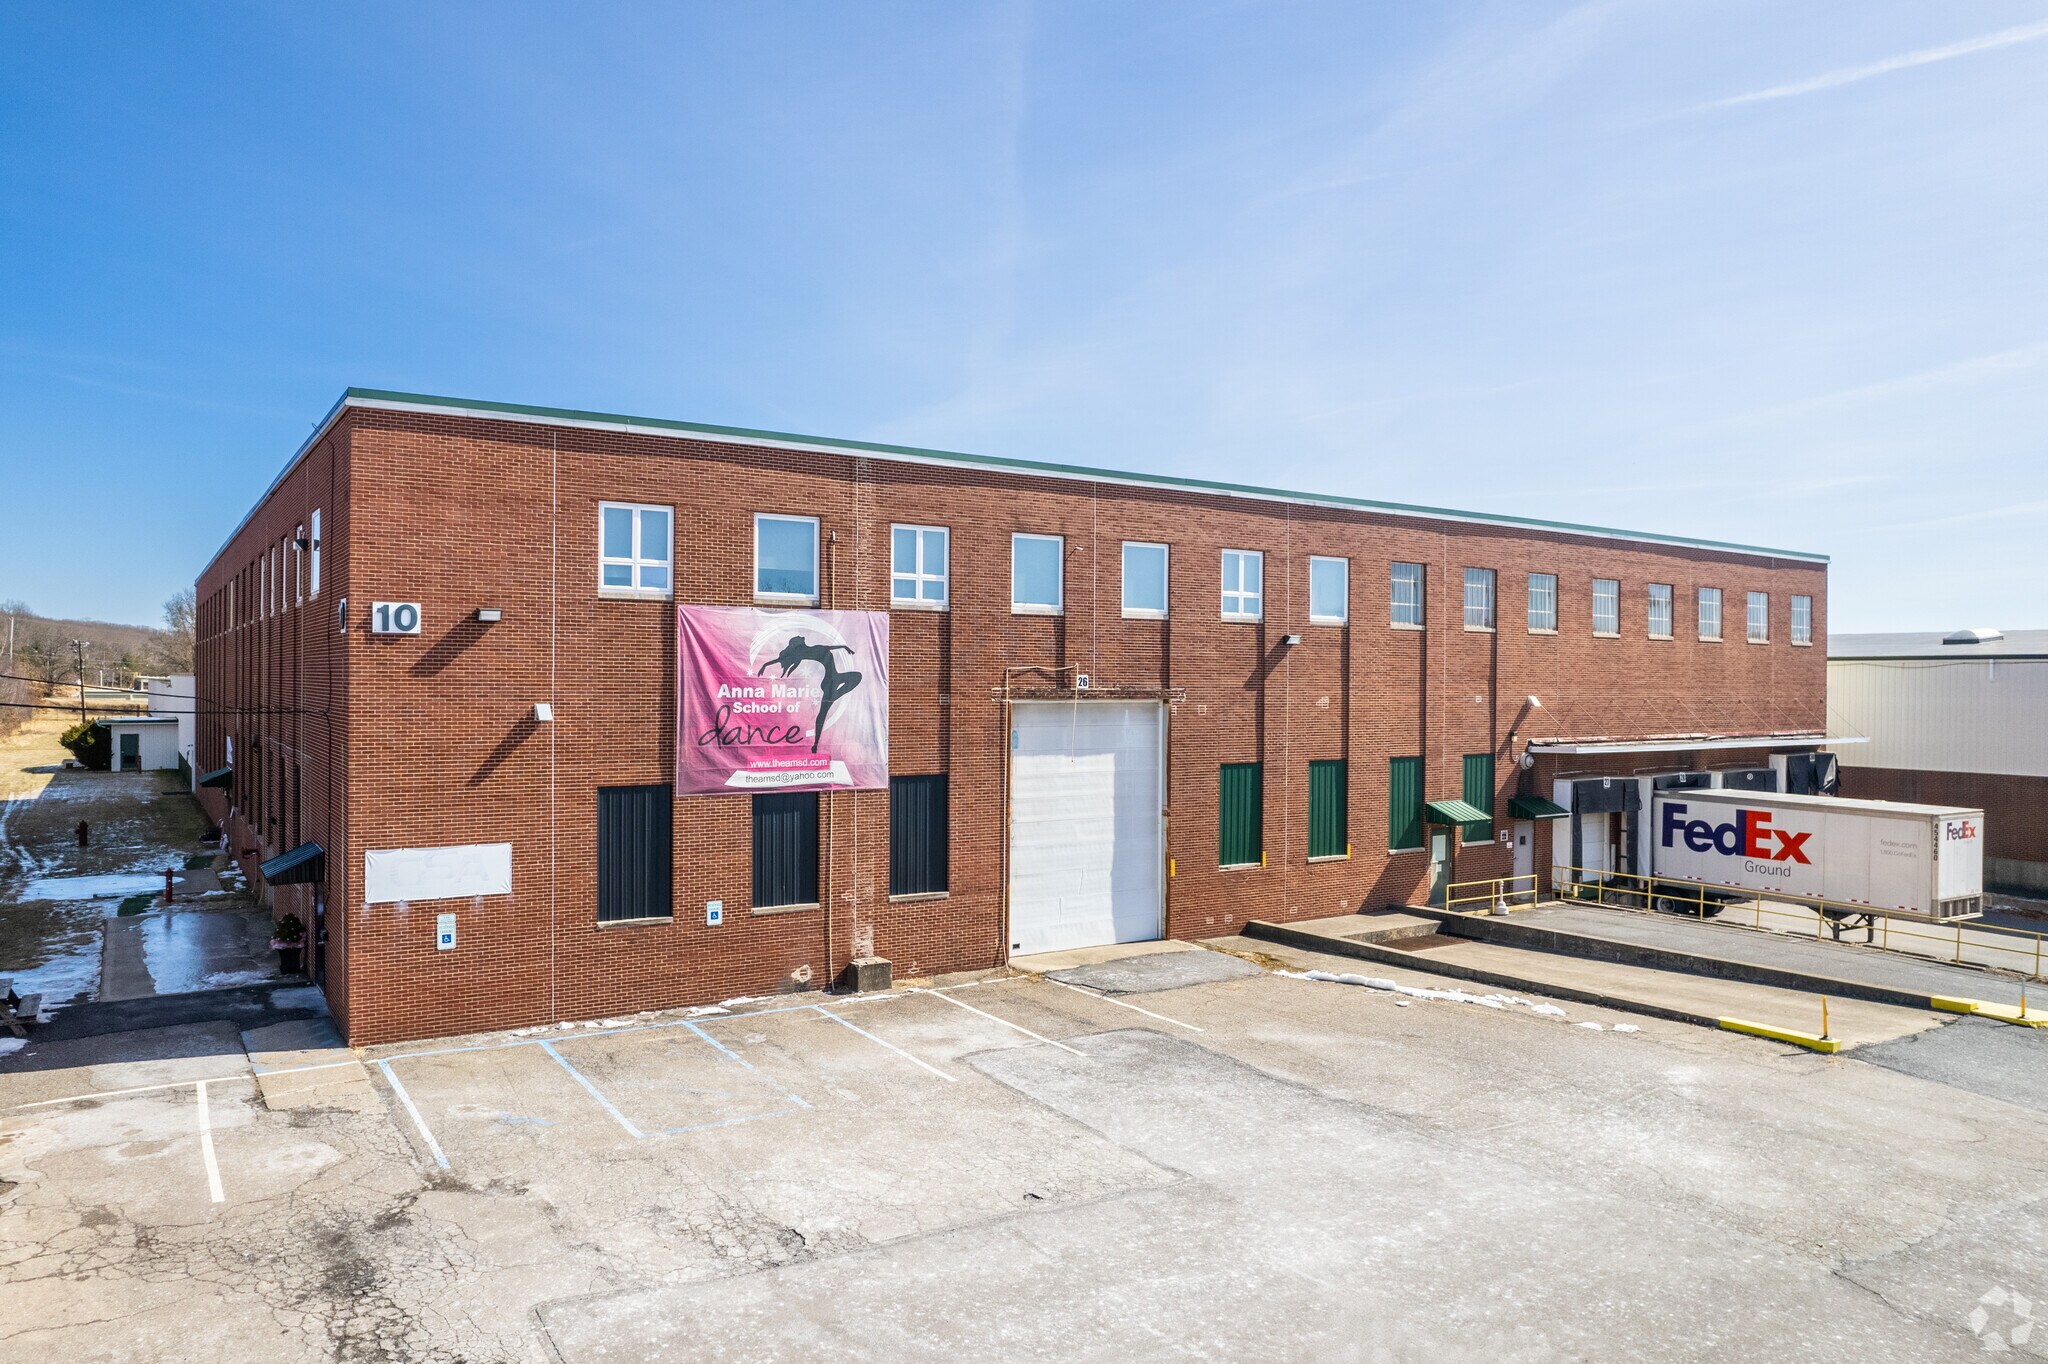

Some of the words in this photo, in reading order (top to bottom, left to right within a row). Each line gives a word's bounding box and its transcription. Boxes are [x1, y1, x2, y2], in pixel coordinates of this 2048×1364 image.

[377, 604, 418, 631] 10
[1078, 676, 1088, 687] 26
[717, 683, 765, 698] Anna
[771, 683, 823, 698] Marie
[732, 701, 782, 714] School
[786, 701, 801, 714] of
[698, 704, 803, 750] dance
[750, 758, 828, 768] www.theamsd.com
[745, 771, 834, 784] theamsd@yahoo.com
[1662, 802, 1813, 865] FedEx
[1946, 820, 1976, 840] FedEx
[1744, 860, 1792, 878] Ground
